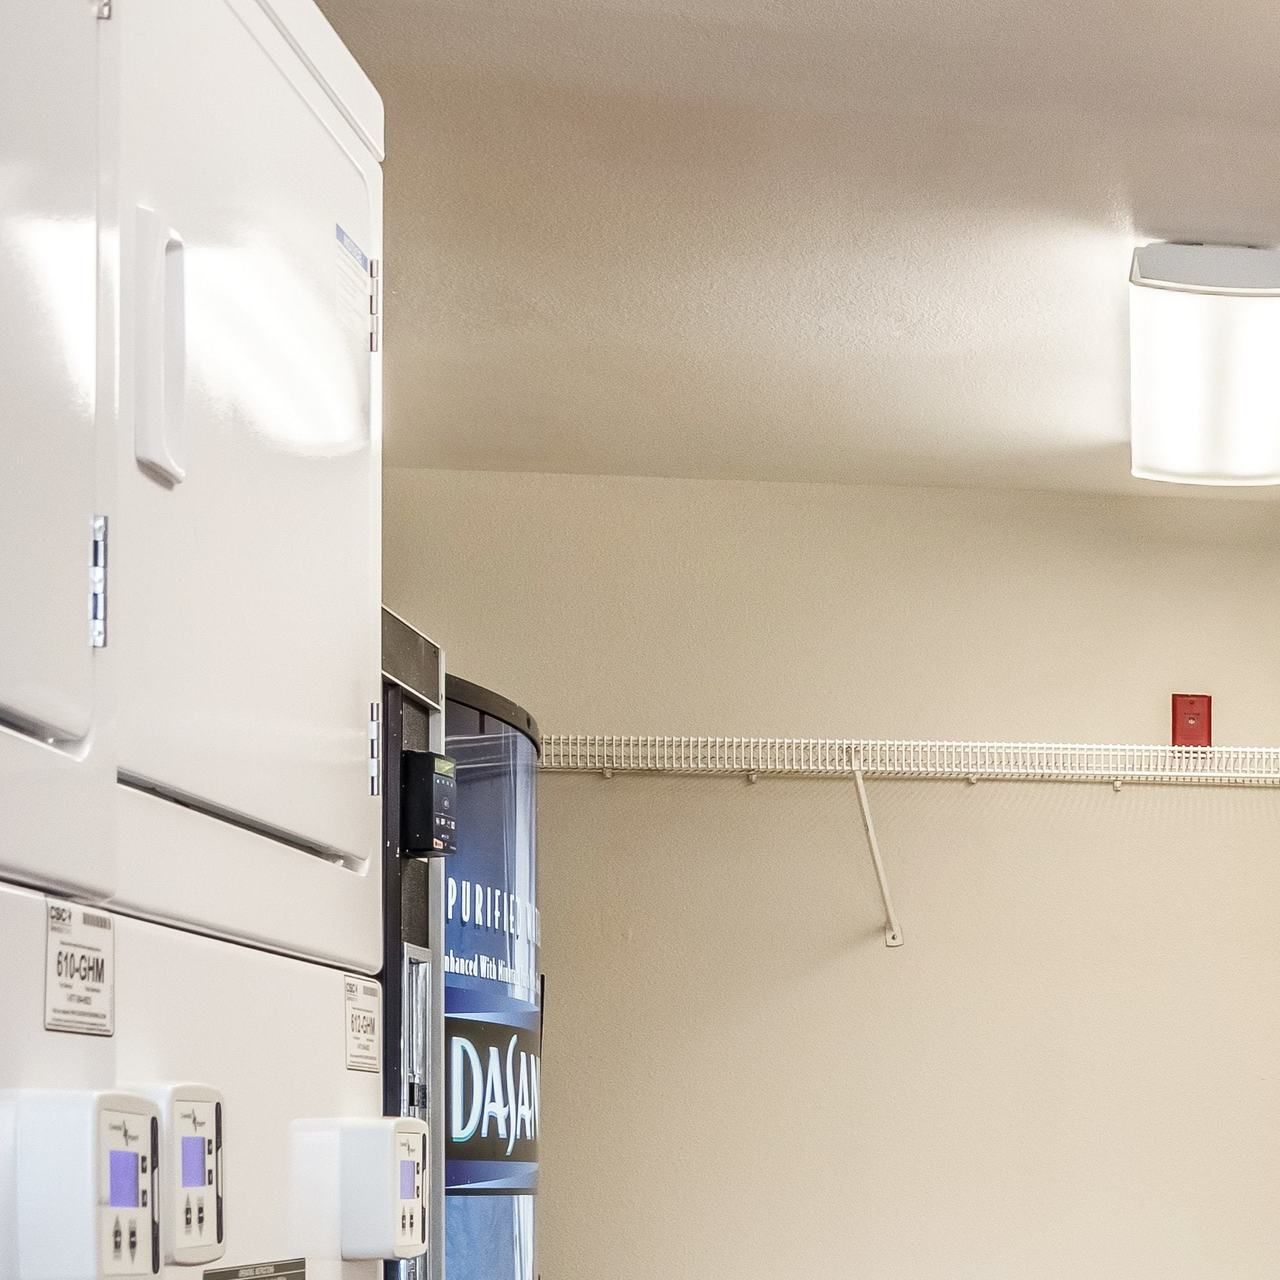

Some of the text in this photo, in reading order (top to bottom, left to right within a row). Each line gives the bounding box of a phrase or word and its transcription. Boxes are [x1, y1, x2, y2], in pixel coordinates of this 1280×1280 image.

[57, 951, 105, 984] 610-GHM
[445, 949, 478, 977] nhanced
[479, 954, 497, 981] With
[451, 1033, 541, 1156] DASAN
